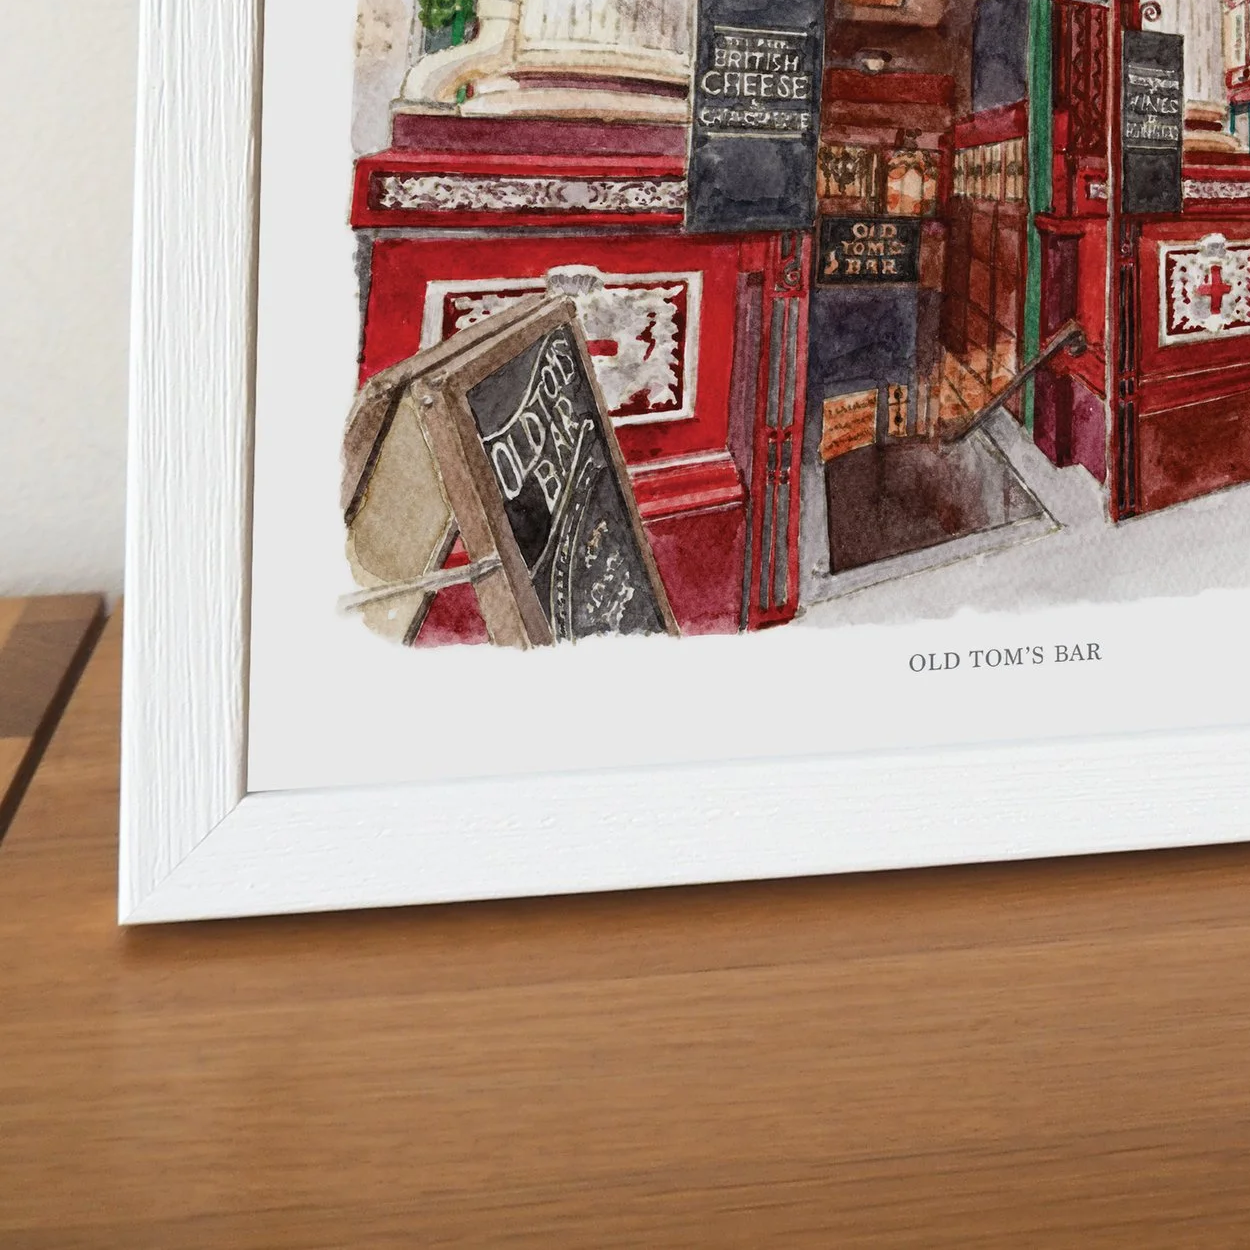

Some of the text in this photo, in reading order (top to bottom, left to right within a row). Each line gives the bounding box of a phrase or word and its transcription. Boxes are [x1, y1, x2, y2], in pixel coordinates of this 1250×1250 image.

[714, 48, 799, 71] BRITISH
[701, 70, 809, 99] CHEESE
[491, 412, 546, 500] OLD
[534, 396, 580, 515] BAR
[909, 643, 1102, 672] OLD TOM'S BAR
